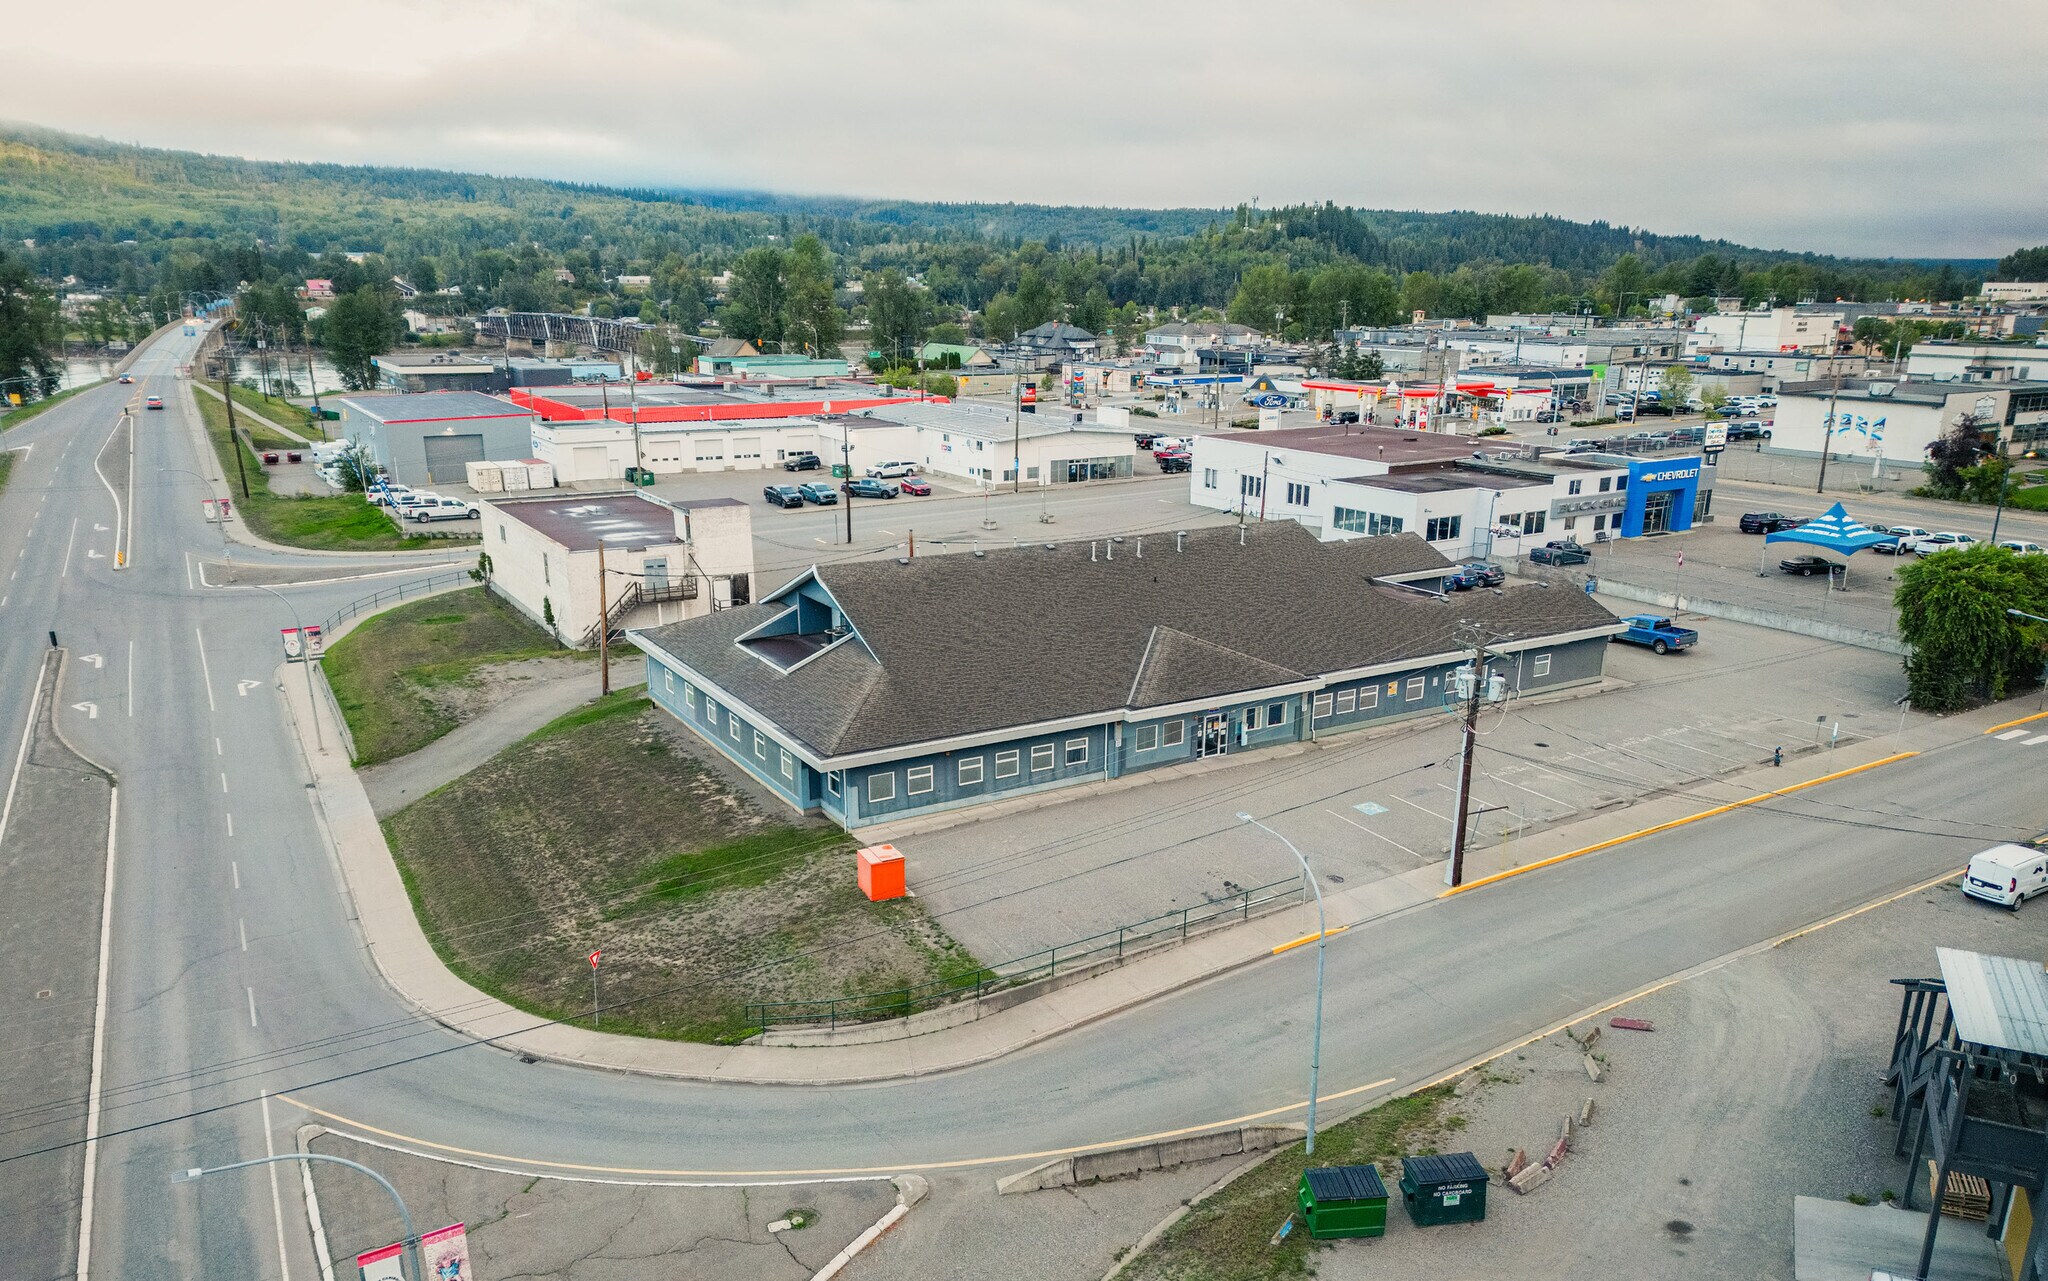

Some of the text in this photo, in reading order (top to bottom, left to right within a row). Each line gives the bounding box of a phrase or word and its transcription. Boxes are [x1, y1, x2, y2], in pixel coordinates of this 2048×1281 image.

[1264, 396, 1282, 406] Ford
[1657, 468, 1699, 481] CHEVROLET
[1557, 496, 1626, 514] BUICK GMC
